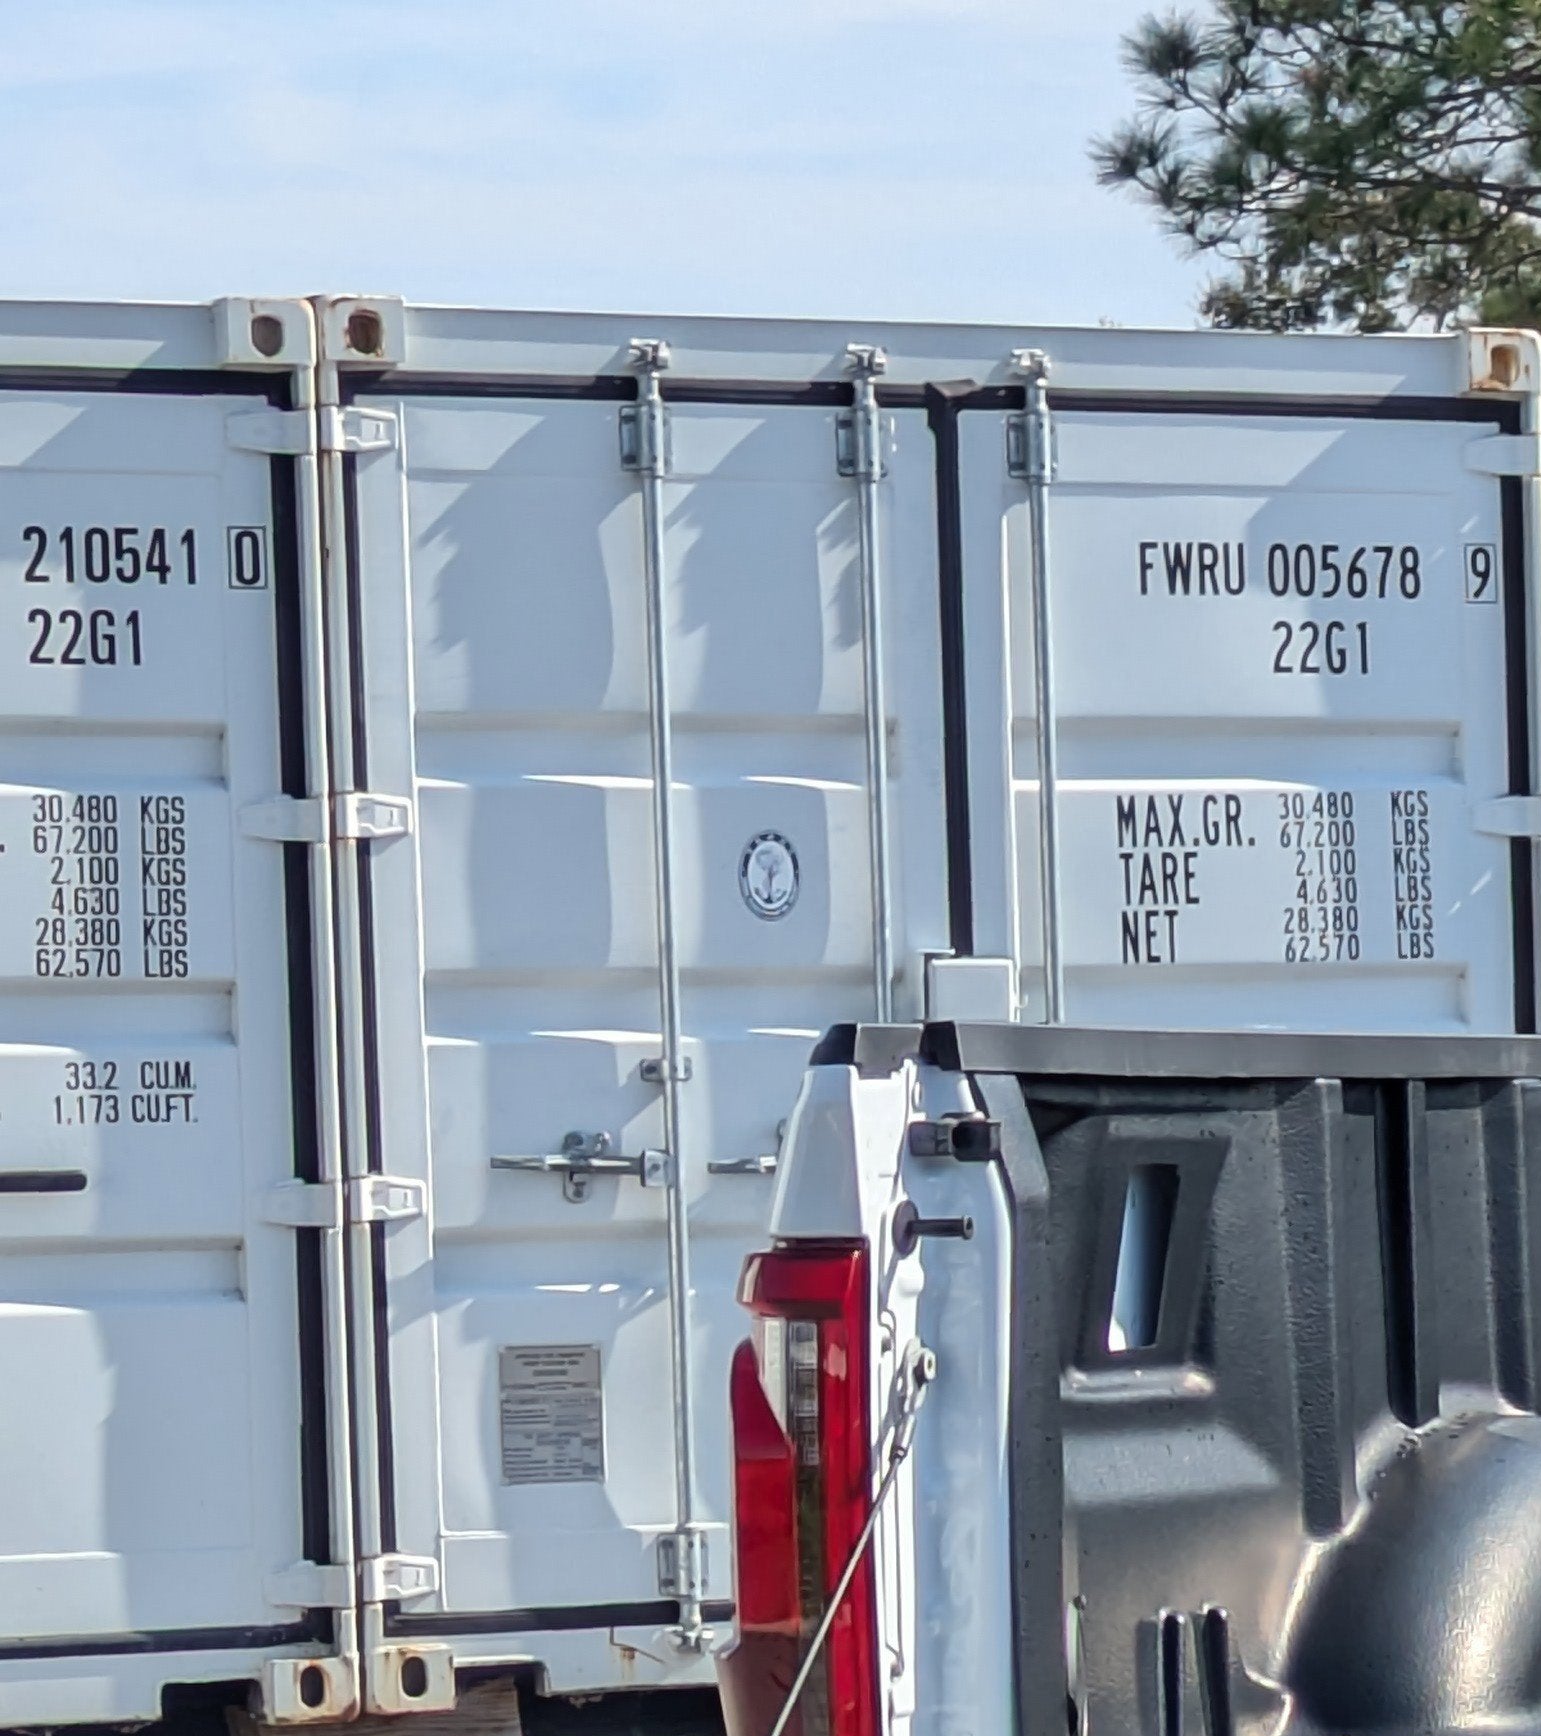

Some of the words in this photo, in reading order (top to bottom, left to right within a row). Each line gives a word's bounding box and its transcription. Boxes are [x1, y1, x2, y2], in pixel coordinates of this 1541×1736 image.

[23, 526, 196, 585] 210541
[235, 529, 260, 584] 0
[1139, 542, 1245, 595] FWRU
[1268, 543, 1420, 599] 005678
[1471, 547, 1490, 599] 9
[28, 608, 141, 665] 22G1
[1273, 621, 1368, 675] 22G1
[141, 796, 184, 824] KGS
[1391, 790, 1428, 818] KGS
[1117, 794, 1255, 848] MAX.GR.
[1392, 817, 1429, 846] LBS
[141, 825, 185, 855] LBS
[142, 856, 185, 885] KGS
[1393, 846, 1430, 874] KGS
[1119, 852, 1200, 906] TARE
[1395, 874, 1431, 902] LBS
[143, 887, 186, 916] LBS
[1396, 904, 1433, 931] KGS
[143, 919, 187, 947] KGS
[1122, 909, 1178, 964] NET
[1397, 931, 1434, 959] LBS
[144, 949, 188, 977] LBS
